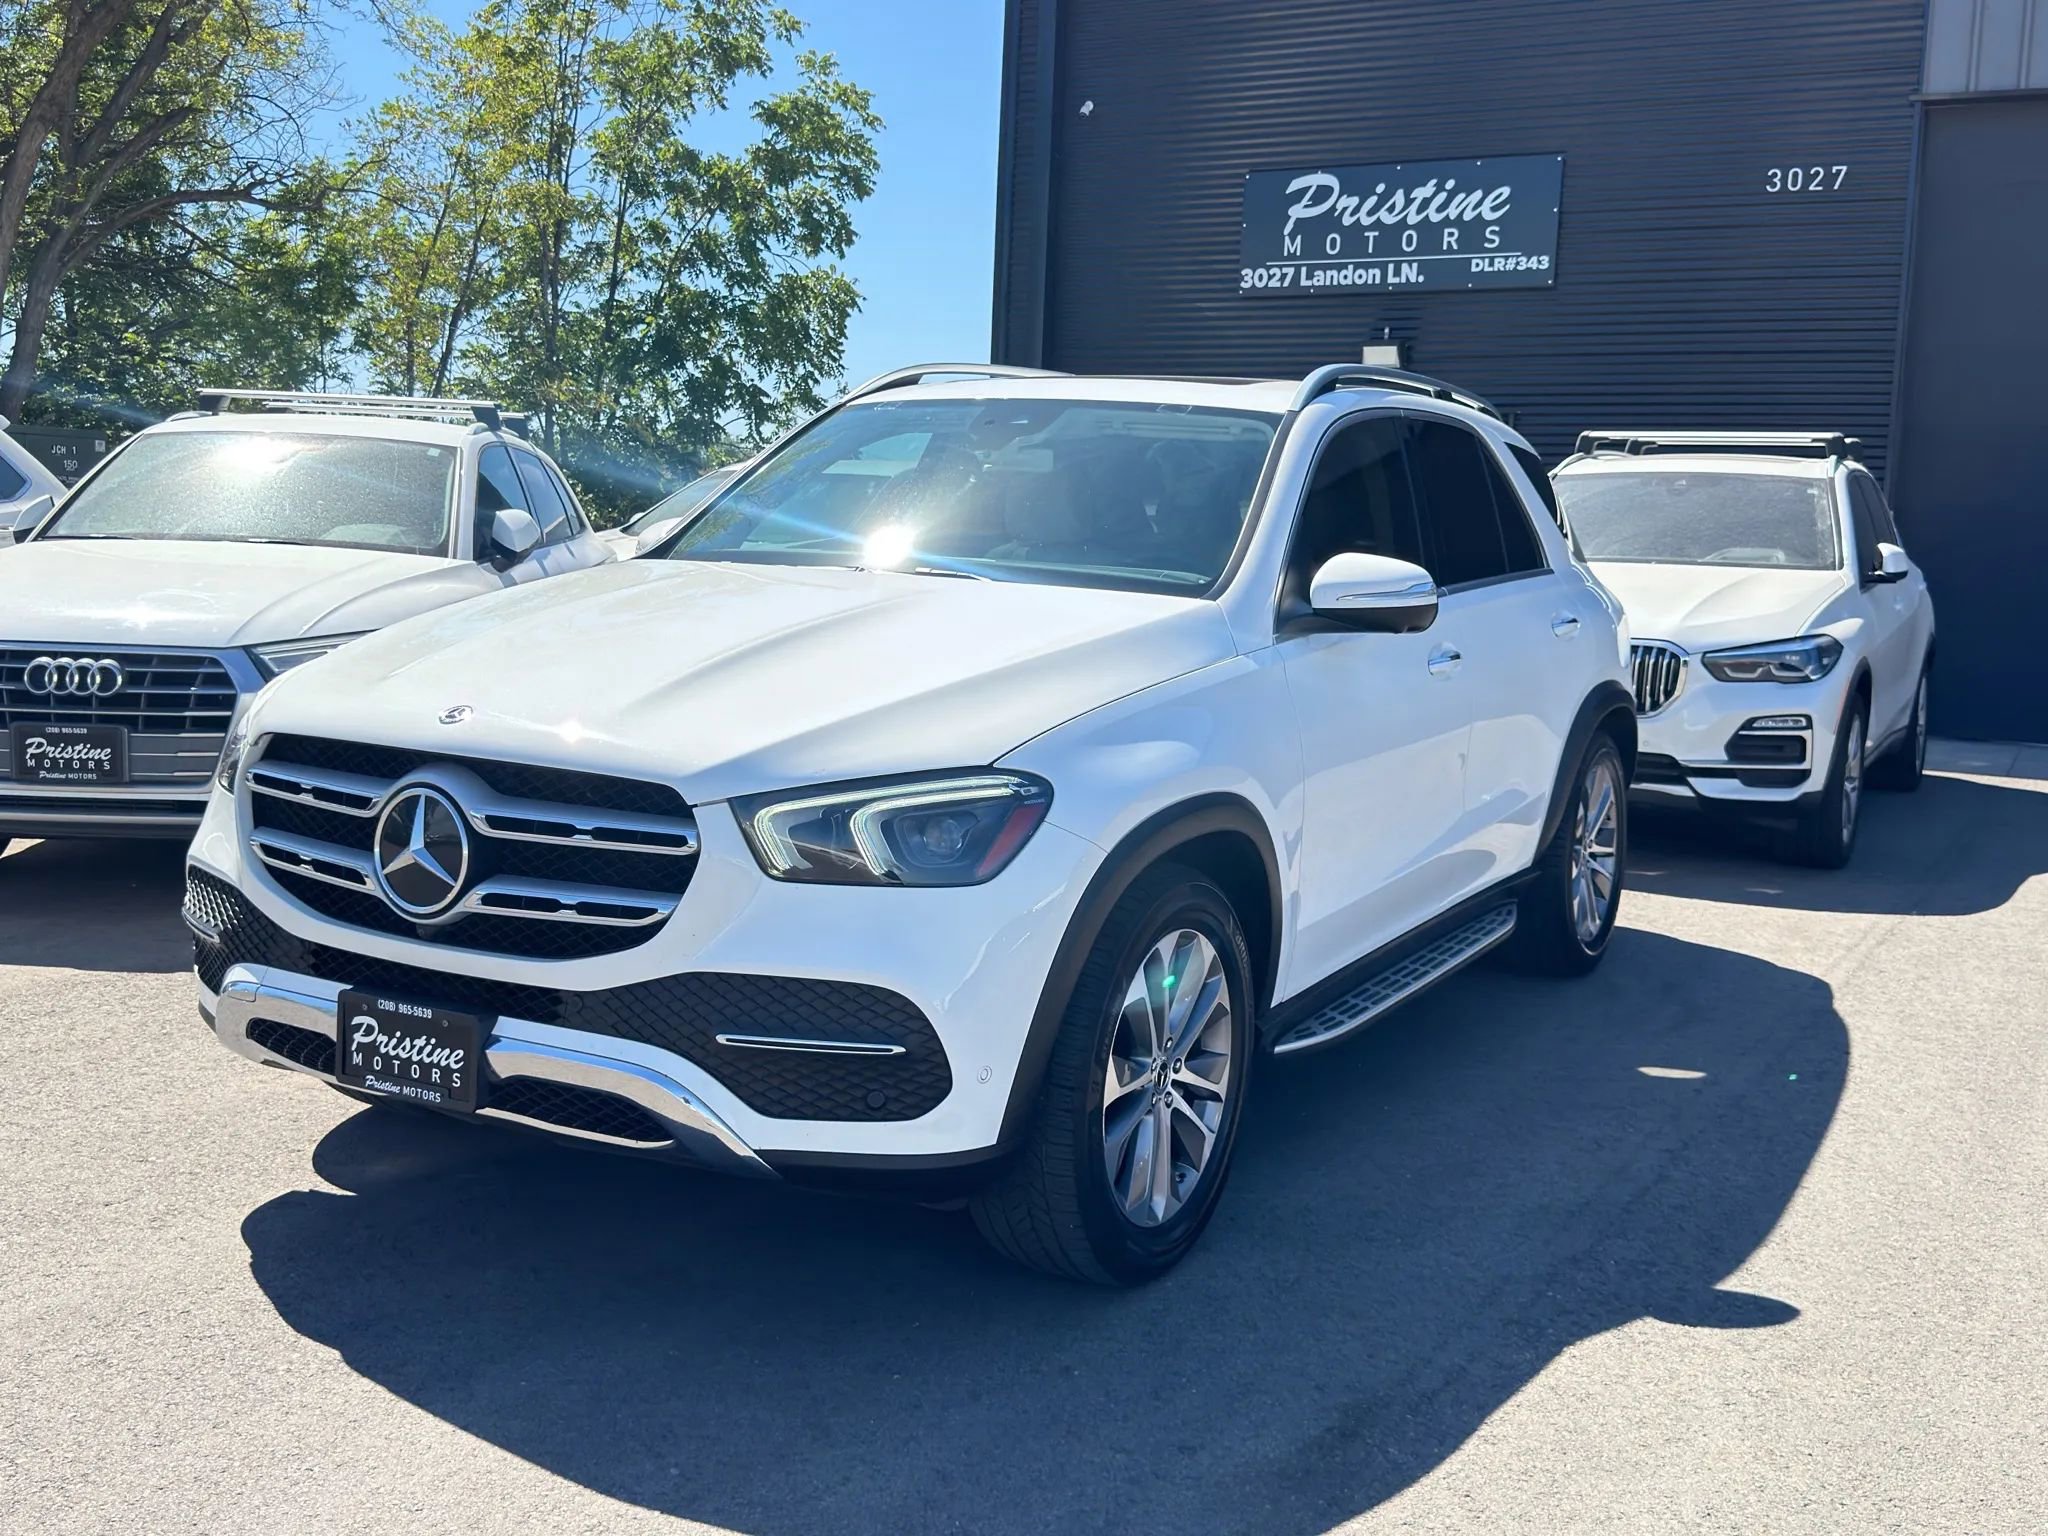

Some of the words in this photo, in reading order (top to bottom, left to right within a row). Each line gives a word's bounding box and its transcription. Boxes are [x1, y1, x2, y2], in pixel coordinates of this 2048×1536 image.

[1765, 165, 1848, 193] 3027
[1283, 173, 1512, 236] Pristine
[1283, 226, 1501, 257] MOTORS
[1240, 266, 1295, 289] 3027
[1300, 264, 1381, 287] Landon
[1387, 262, 1425, 284] LN.
[1470, 255, 1550, 273] DLR#343
[51, 445, 67, 454] JCH
[63, 460, 78, 469] 150
[25, 737, 112, 760] Pristine
[27, 758, 111, 770] MOTORS
[39, 770, 67, 779] Pristine
[67, 772, 97, 780] MOTORS
[377, 999, 396, 1012] (208)
[398, 1003, 433, 1019] 965-5639
[351, 1015, 465, 1070] Pristine
[352, 1051, 462, 1088] MOTORS
[365, 1075, 401, 1094] Pristine
[402, 1085, 442, 1103] MOTORS
